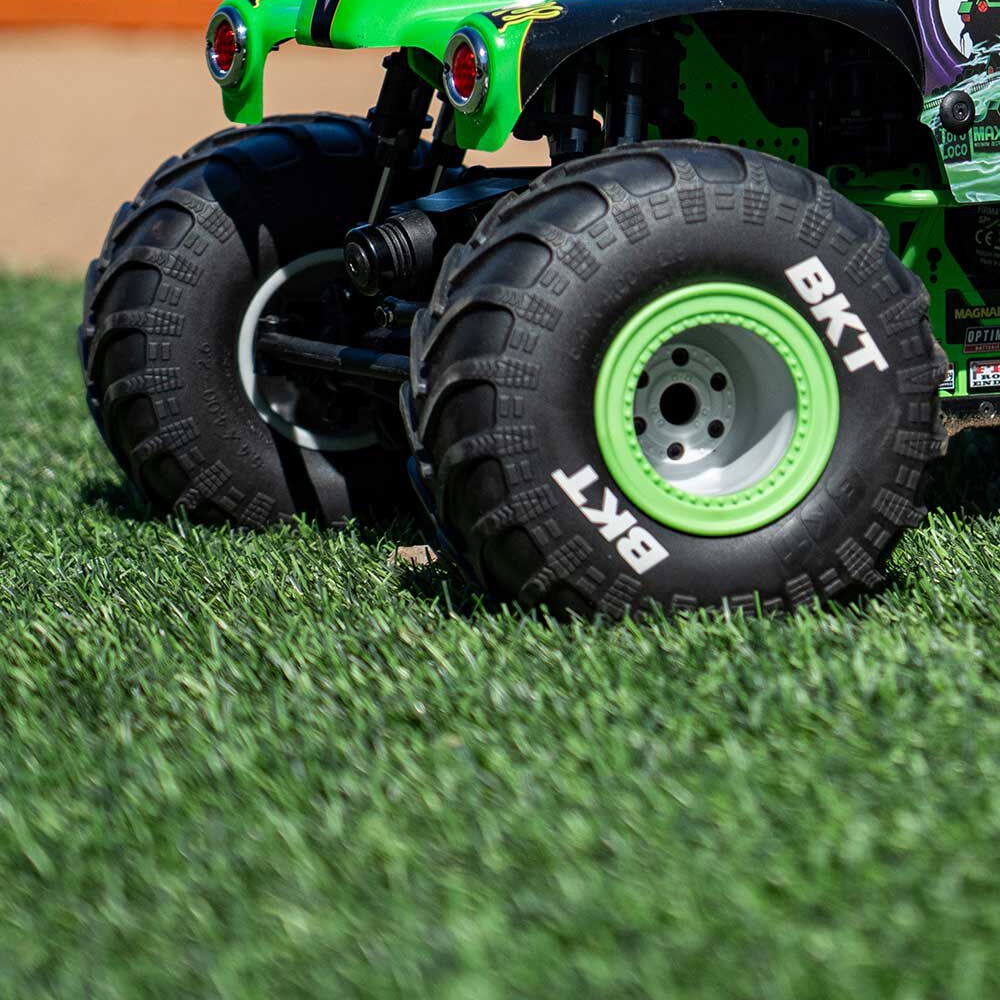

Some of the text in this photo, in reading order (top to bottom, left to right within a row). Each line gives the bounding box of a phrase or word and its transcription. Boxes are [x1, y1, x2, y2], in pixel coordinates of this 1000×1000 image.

[940, 143, 968, 160] LOCO
[784, 255, 889, 372] BKT
[550, 464, 670, 575] BKT
